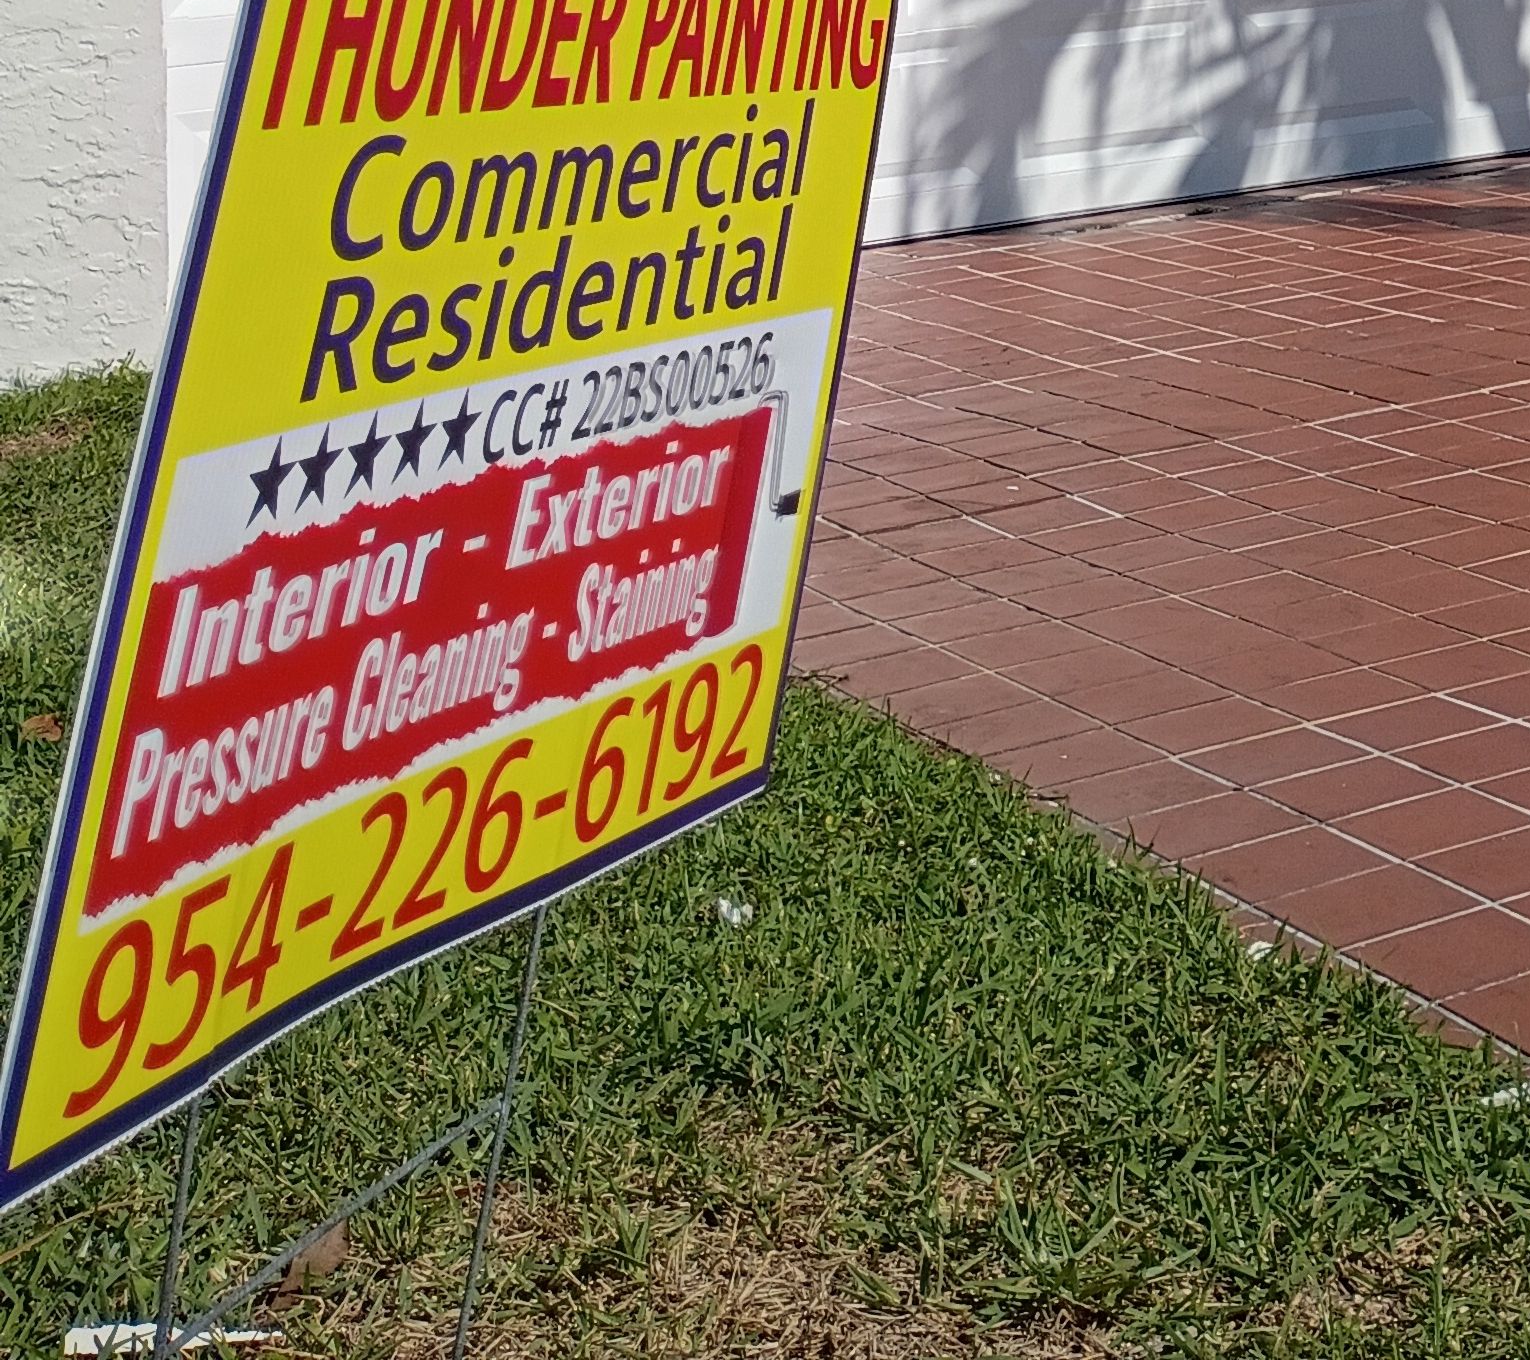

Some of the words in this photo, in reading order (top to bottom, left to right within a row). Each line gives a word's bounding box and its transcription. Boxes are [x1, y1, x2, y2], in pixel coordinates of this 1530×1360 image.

[330, 99, 816, 261] Commercial
[300, 205, 795, 403] Residential
[481, 378, 569, 466] CC#
[571, 332, 775, 440] 22BS00526
[157, 524, 440, 697] Interior
[463, 532, 487, 553] -
[505, 442, 730, 571] Exterior
[112, 687, 334, 857] Pressure
[342, 602, 536, 751] Cleaning
[567, 539, 722, 662] Staining
[62, 643, 764, 1120] 954-226-6192
